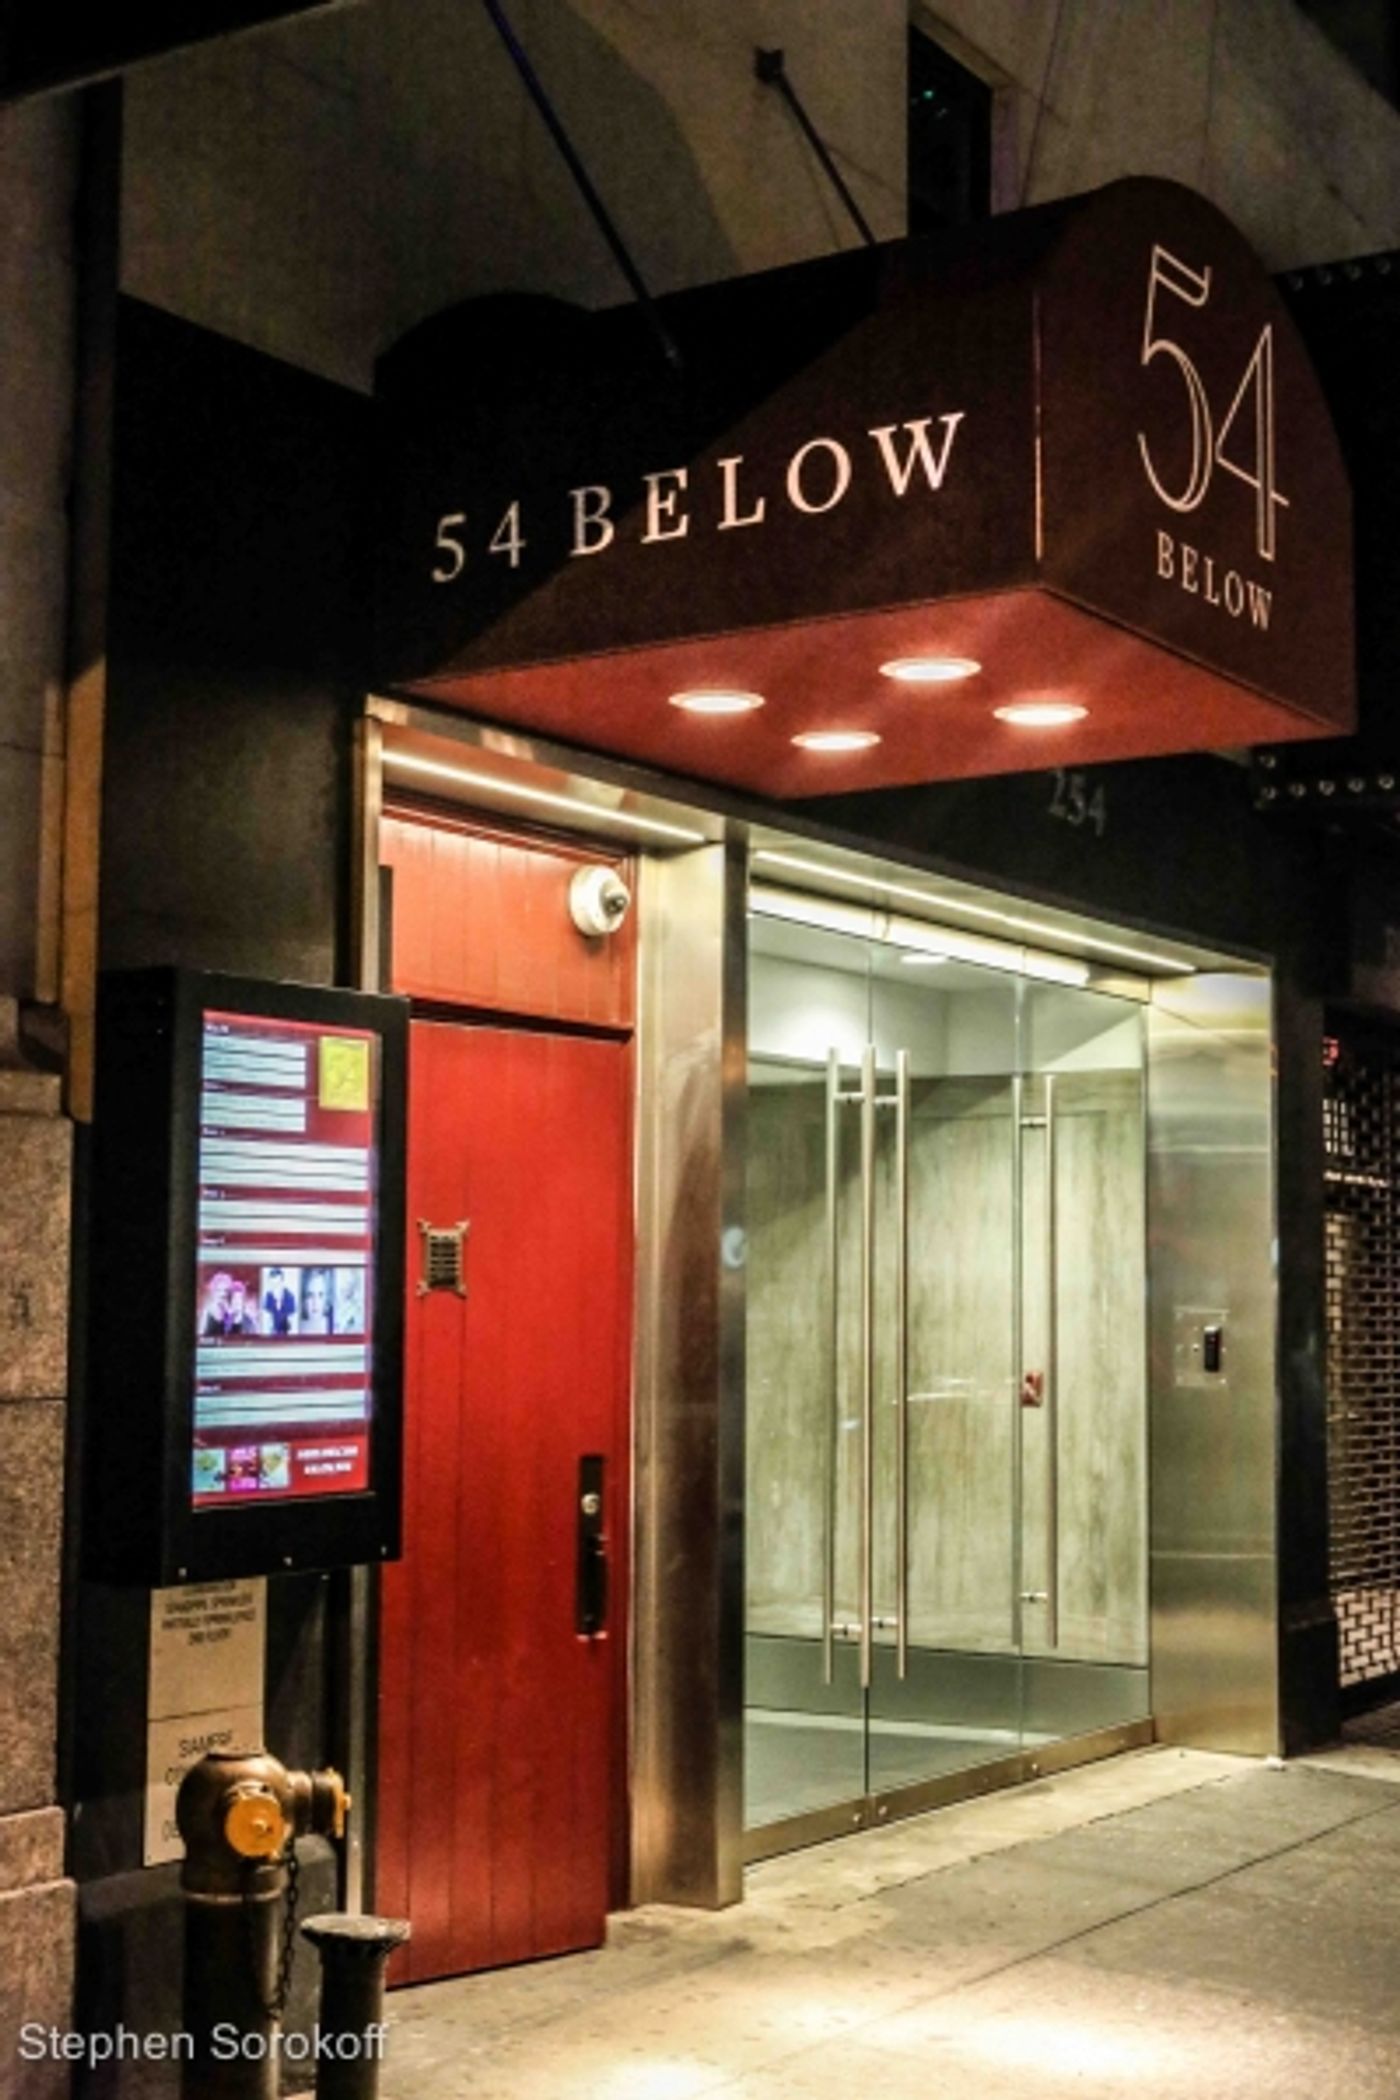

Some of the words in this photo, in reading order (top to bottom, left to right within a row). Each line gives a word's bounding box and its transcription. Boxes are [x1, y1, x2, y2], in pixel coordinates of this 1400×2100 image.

[1138, 245, 1289, 562] 54
[433, 502, 525, 582] 54
[571, 412, 965, 555] BELOW
[1157, 530, 1272, 630] BELOW
